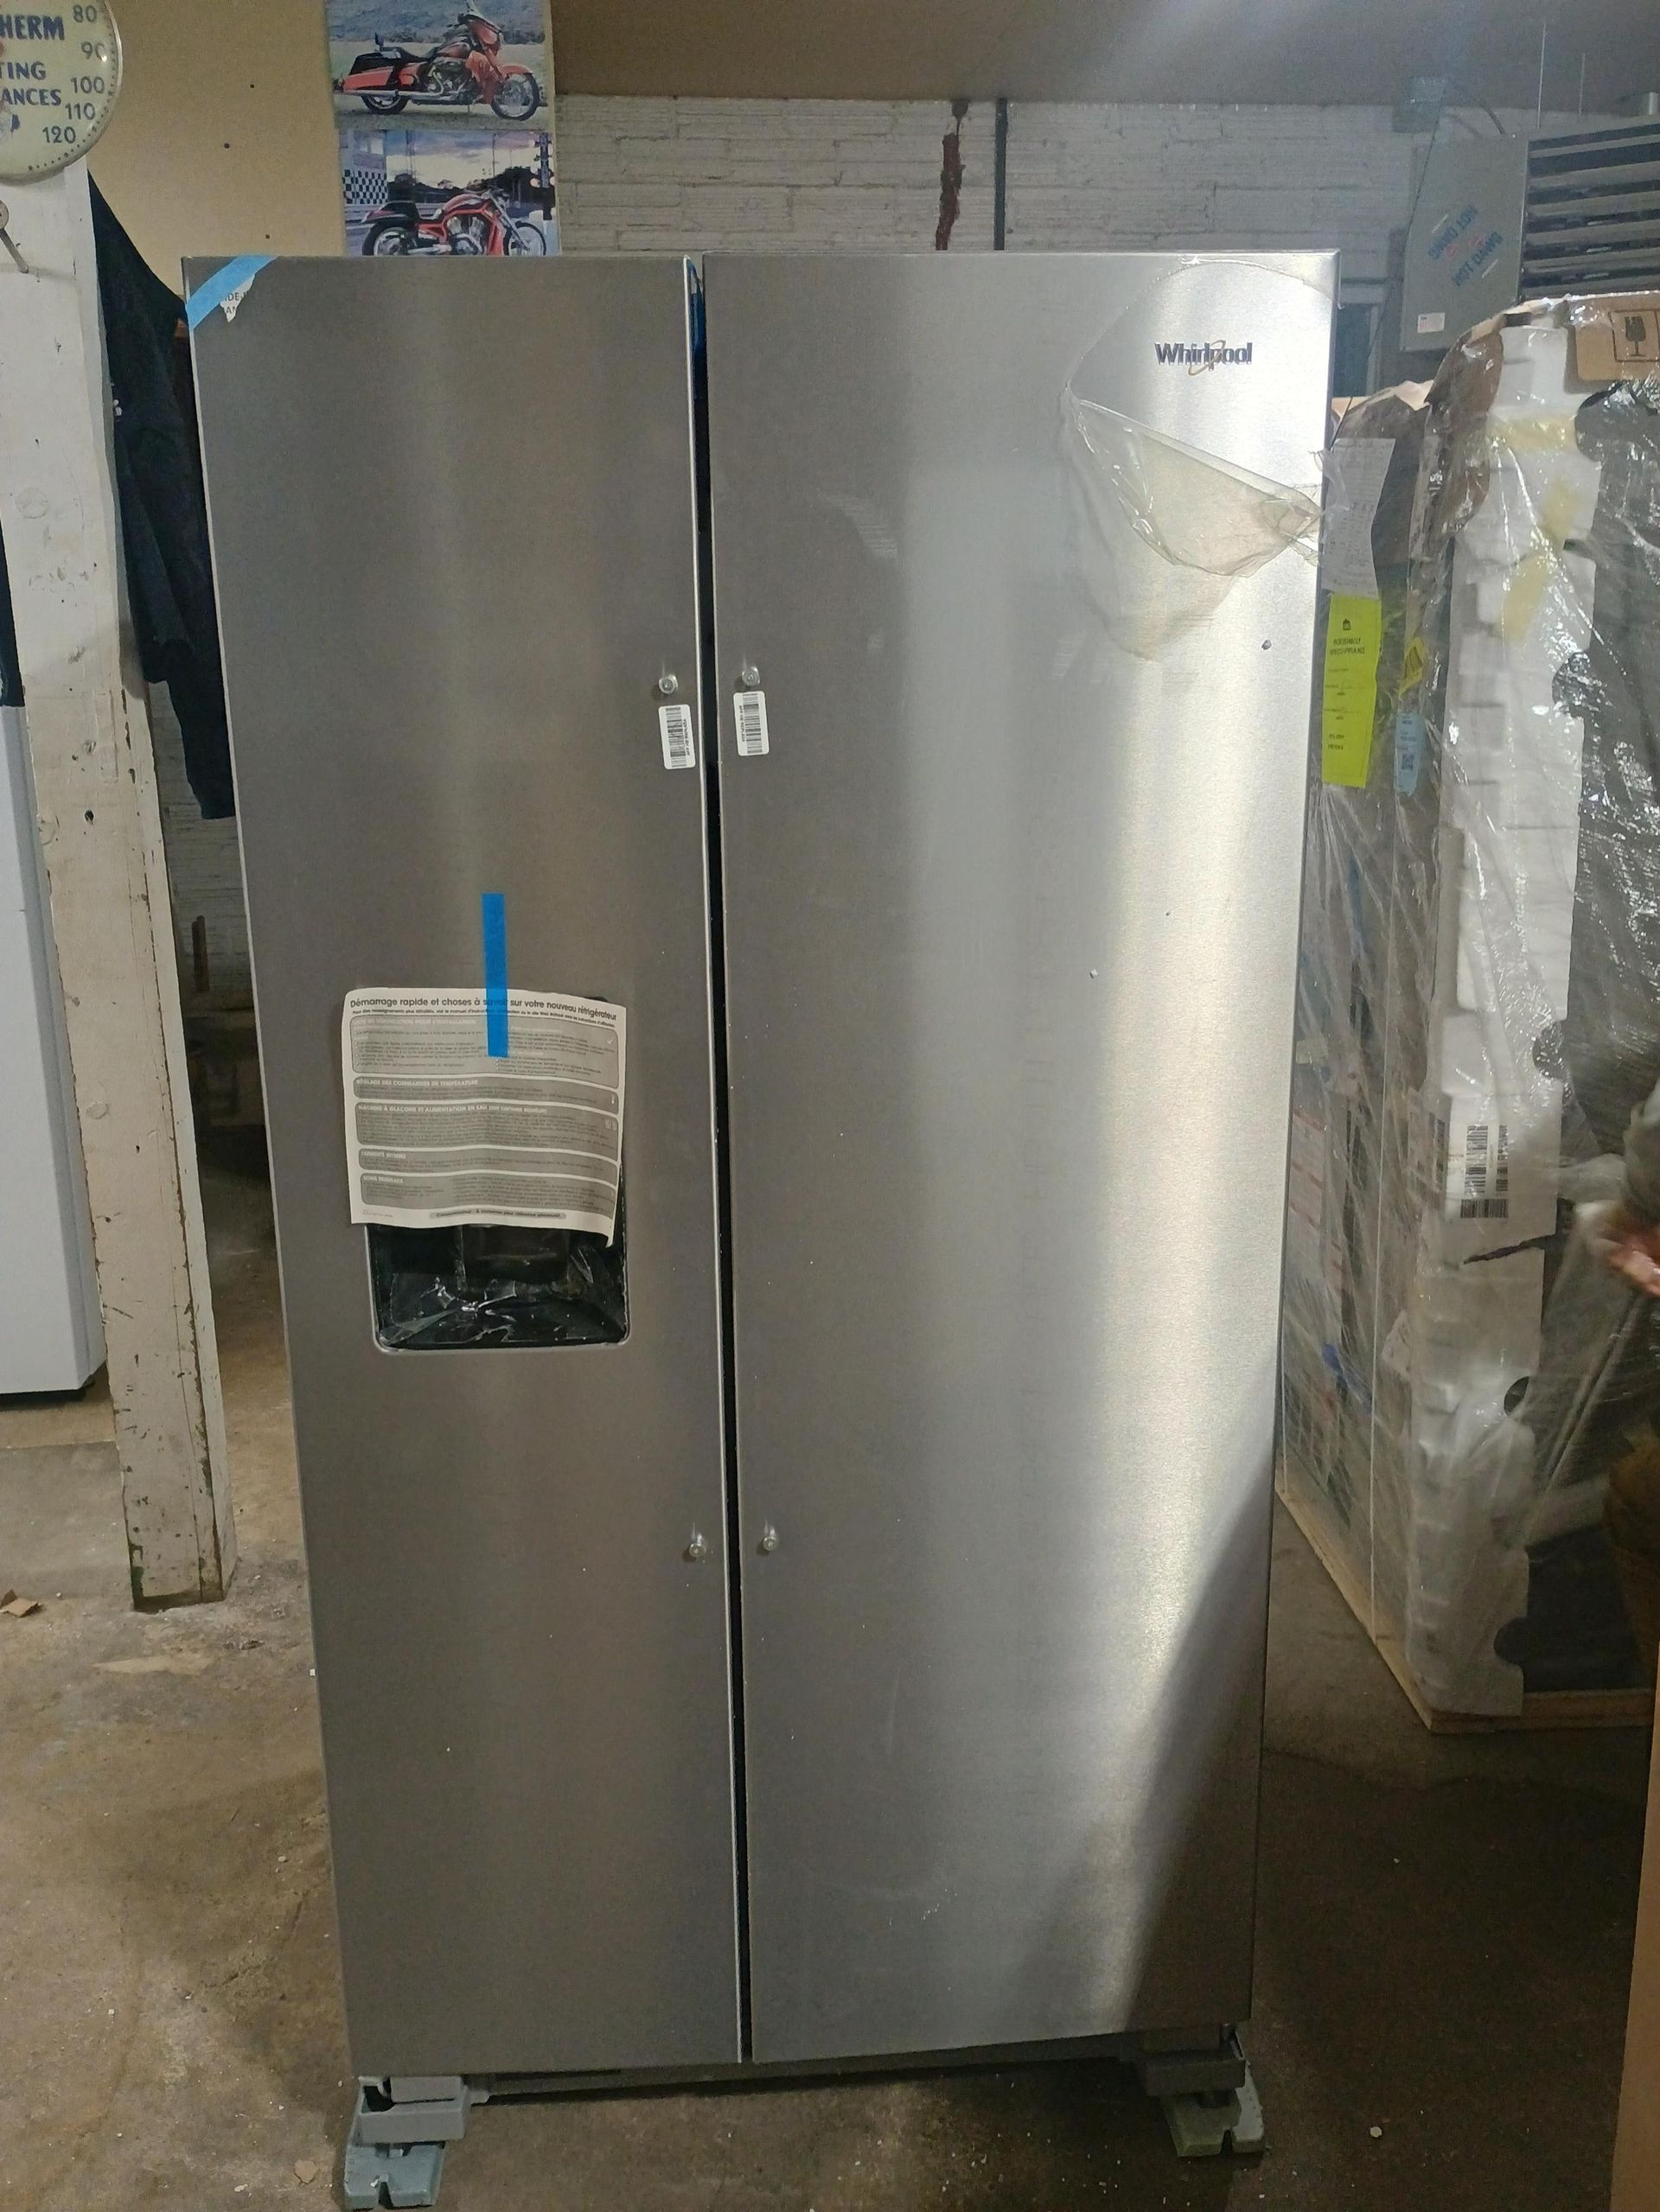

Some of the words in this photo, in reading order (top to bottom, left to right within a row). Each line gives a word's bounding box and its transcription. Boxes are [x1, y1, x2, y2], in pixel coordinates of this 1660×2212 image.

[73, 4, 98, 23] 80
[81, 41, 106, 61] 90
[71, 76, 105, 94] 100
[65, 103, 95, 120] 110
[42, 126, 76, 143] 120
[1154, 341, 1253, 373] Whirlpool
[350, 998, 398, 1008] Démarrage
[399, 997, 428, 1007] rapide
[474, 997, 481, 1005] à
[524, 1000, 545, 1009] votre
[546, 1001, 577, 1012] nouveau
